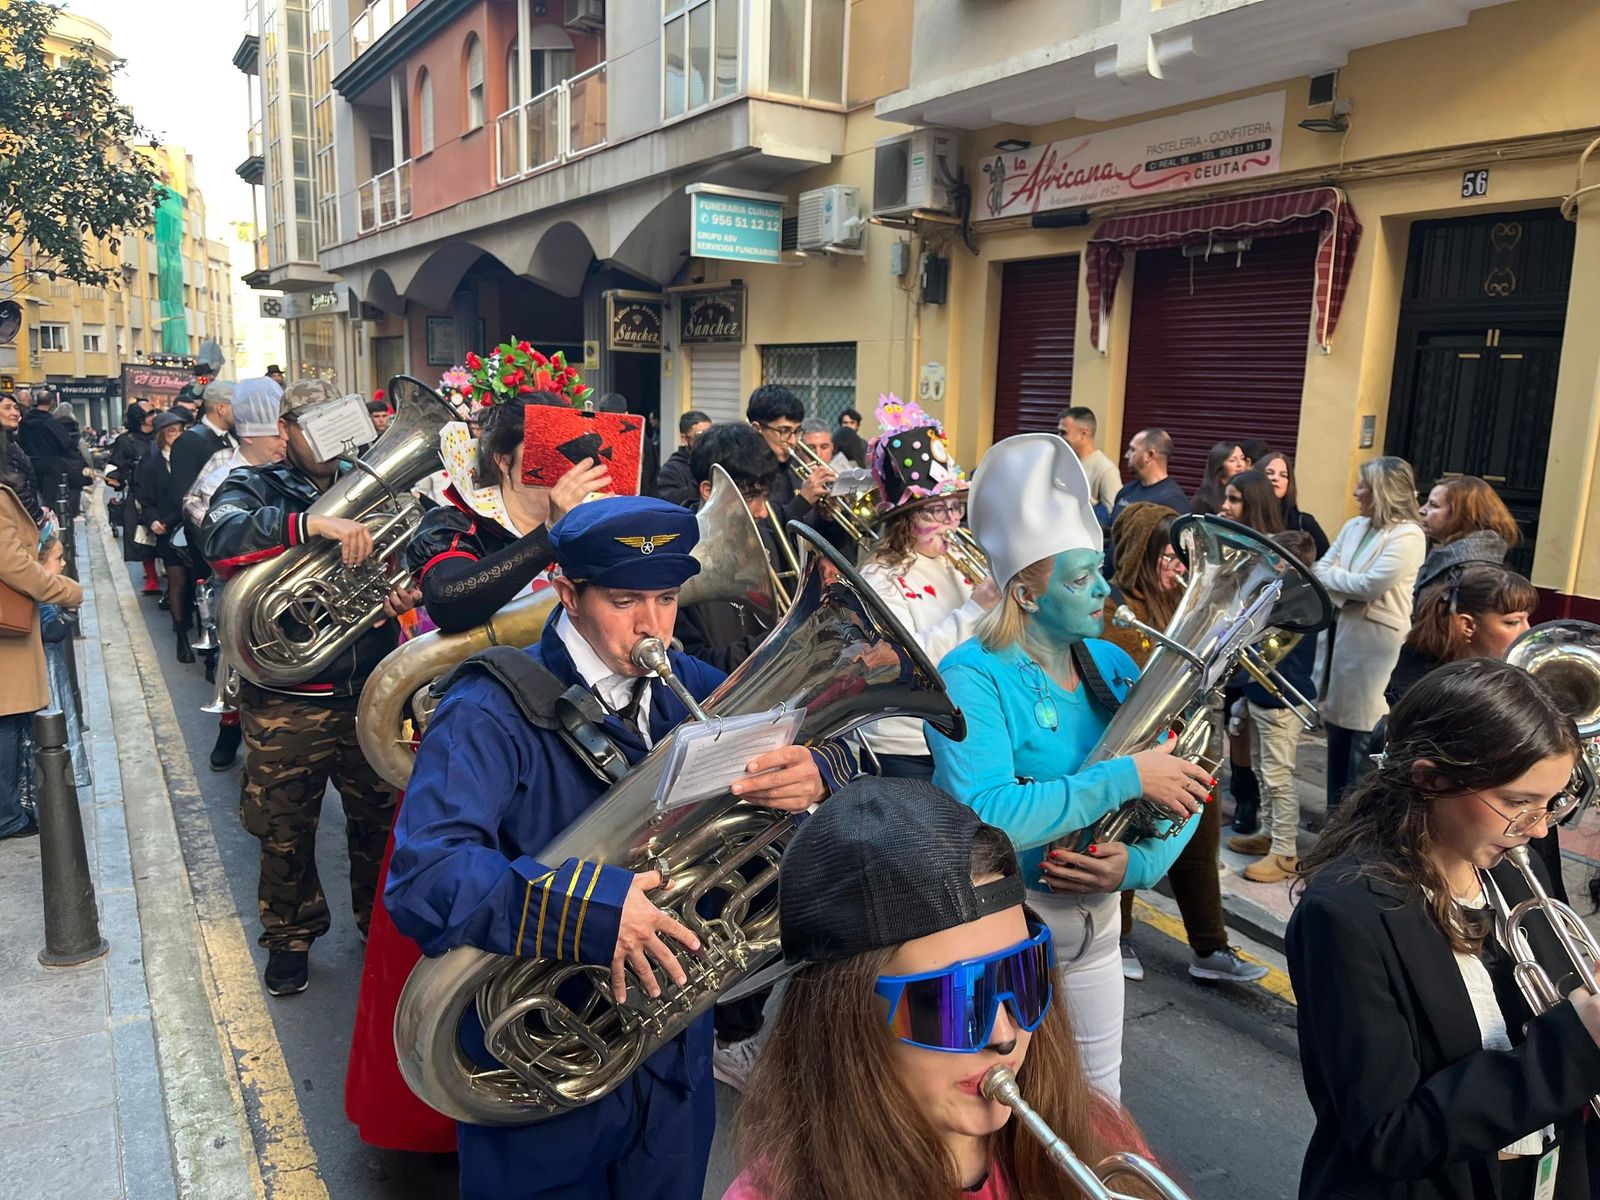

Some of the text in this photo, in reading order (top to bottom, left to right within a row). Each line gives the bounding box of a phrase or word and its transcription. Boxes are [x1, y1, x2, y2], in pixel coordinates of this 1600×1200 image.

[1146, 134, 1202, 156] PASTELERIA
[1209, 121, 1272, 144] CONFITERIA
[1159, 158, 1178, 168] REAL
[1194, 161, 1240, 180] CEUTA
[1004, 144, 1120, 208] Africana
[1463, 170, 1488, 197] 56
[700, 200, 780, 218] FUNERARIA CURADO
[711, 214, 780, 232] 956 51 12 12
[697, 231, 722, 241] GRUPO
[697, 241, 780, 257] SERVICIOS FUNERARIOS
[614, 324, 659, 341] Sánchez
[685, 315, 739, 337] Sánchez
